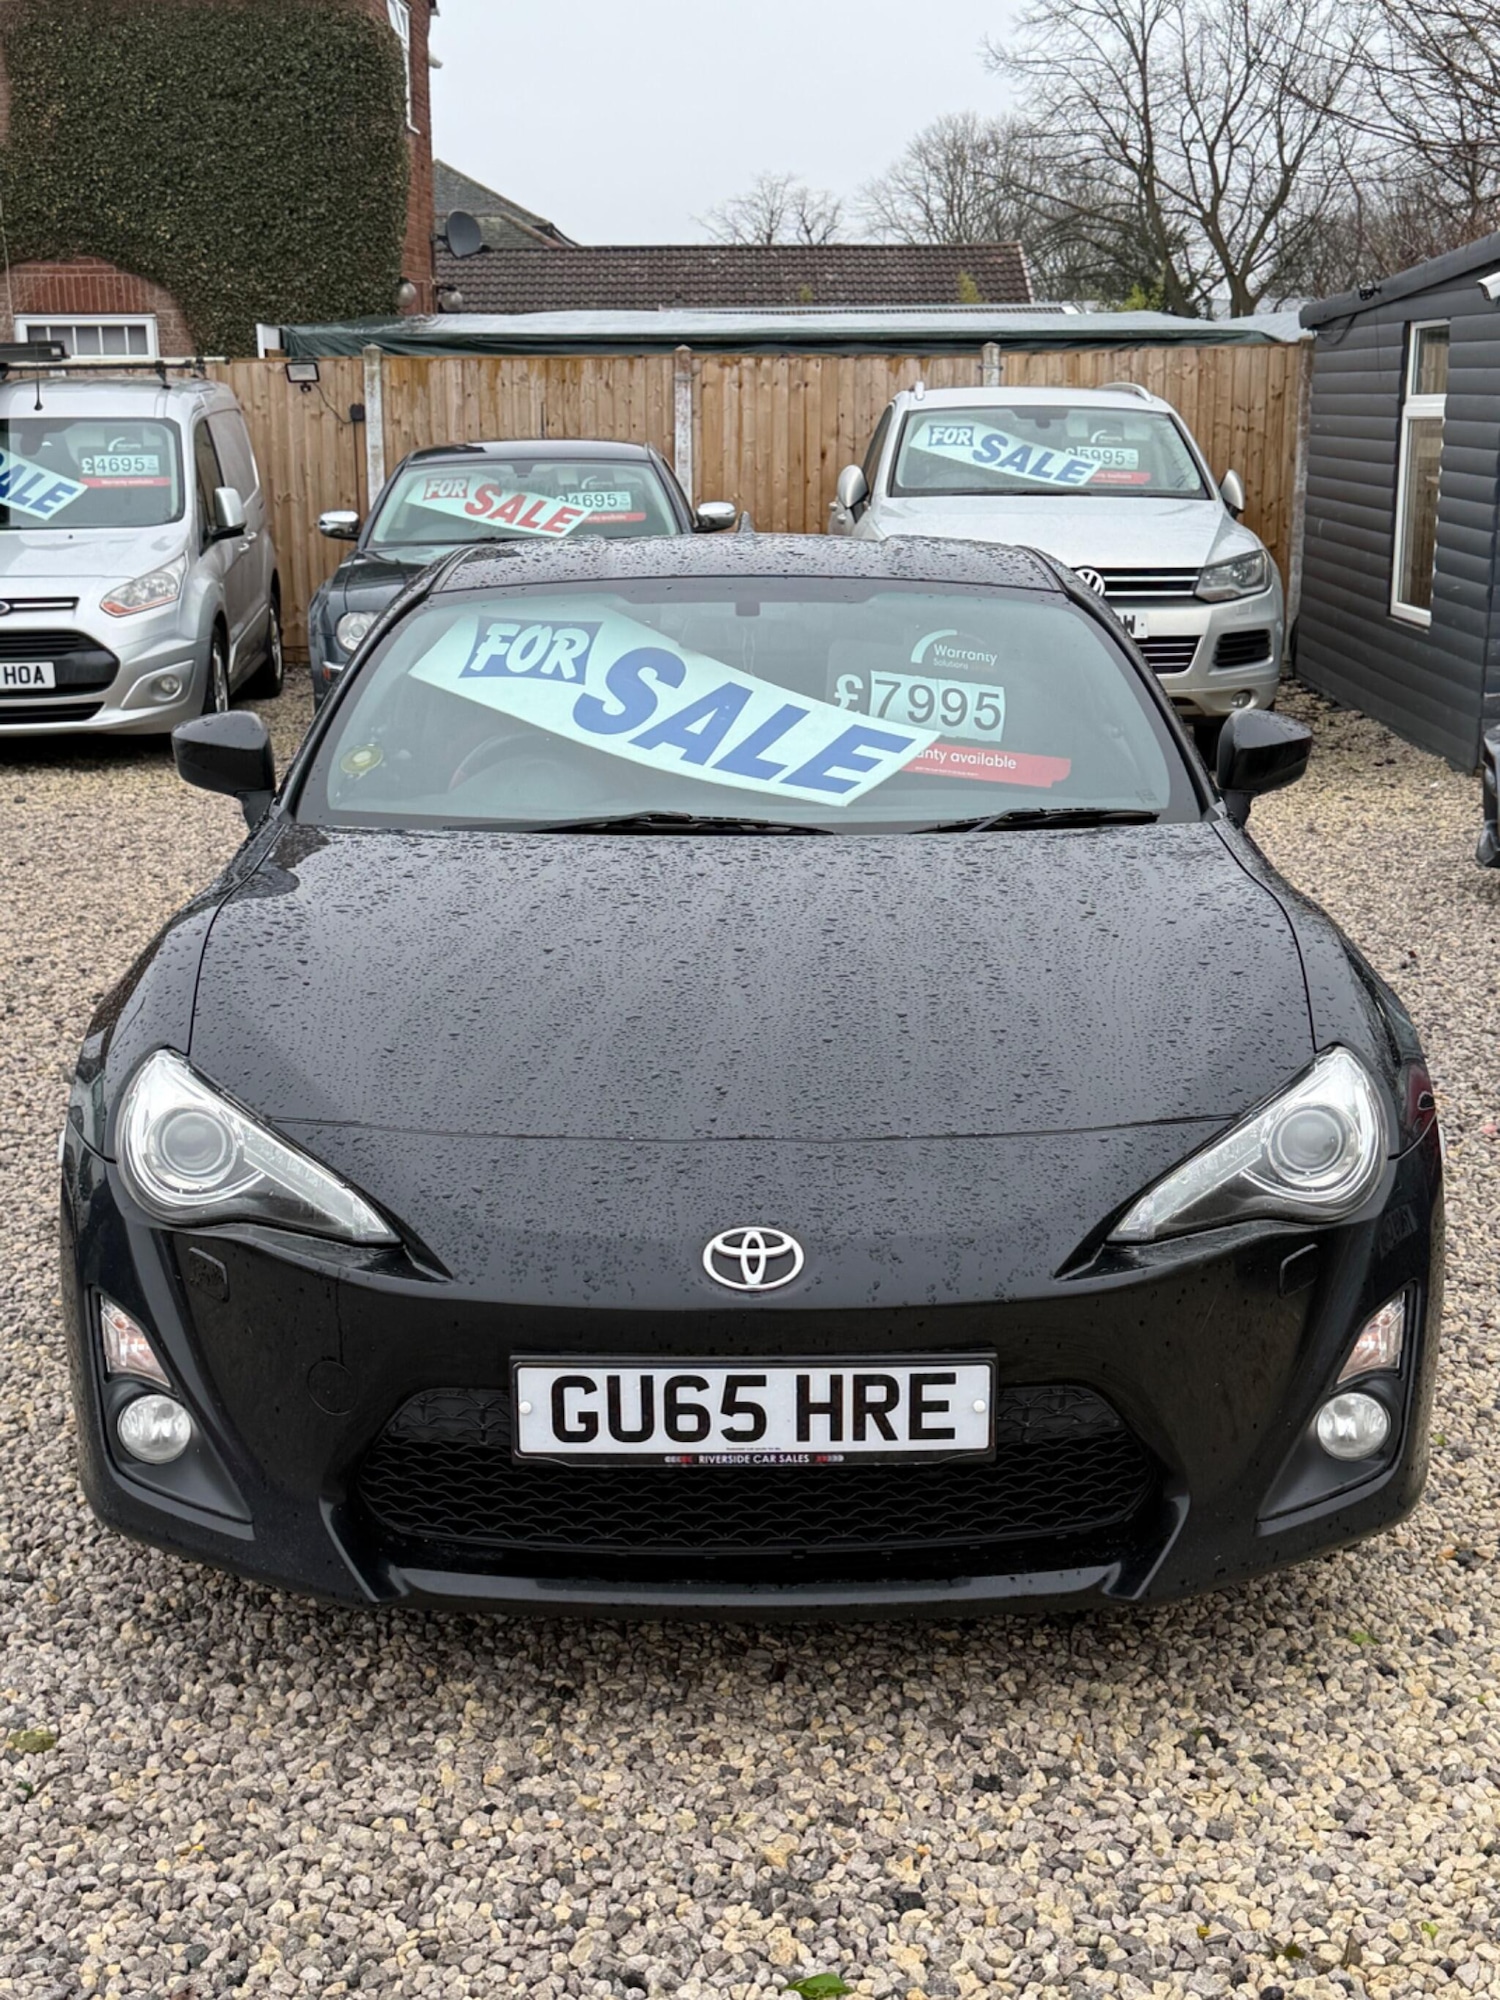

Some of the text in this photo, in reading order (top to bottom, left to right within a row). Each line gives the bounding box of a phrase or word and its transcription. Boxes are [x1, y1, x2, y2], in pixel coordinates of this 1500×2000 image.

[82, 457, 146, 475] £4695
[931, 427, 1096, 485] FOR SALE
[425, 478, 585, 534] FOR SALE
[932, 657, 969, 670] Solutions
[933, 643, 998, 667] Warranty
[3, 665, 46, 685] HOA
[469, 623, 916, 795] FOR SALE
[834, 673, 1002, 732] £7995
[950, 751, 1018, 769] available
[551, 1372, 957, 1443] GU65 HRE
[698, 1453, 810, 1464] RIVERSIDE CAR SALES
